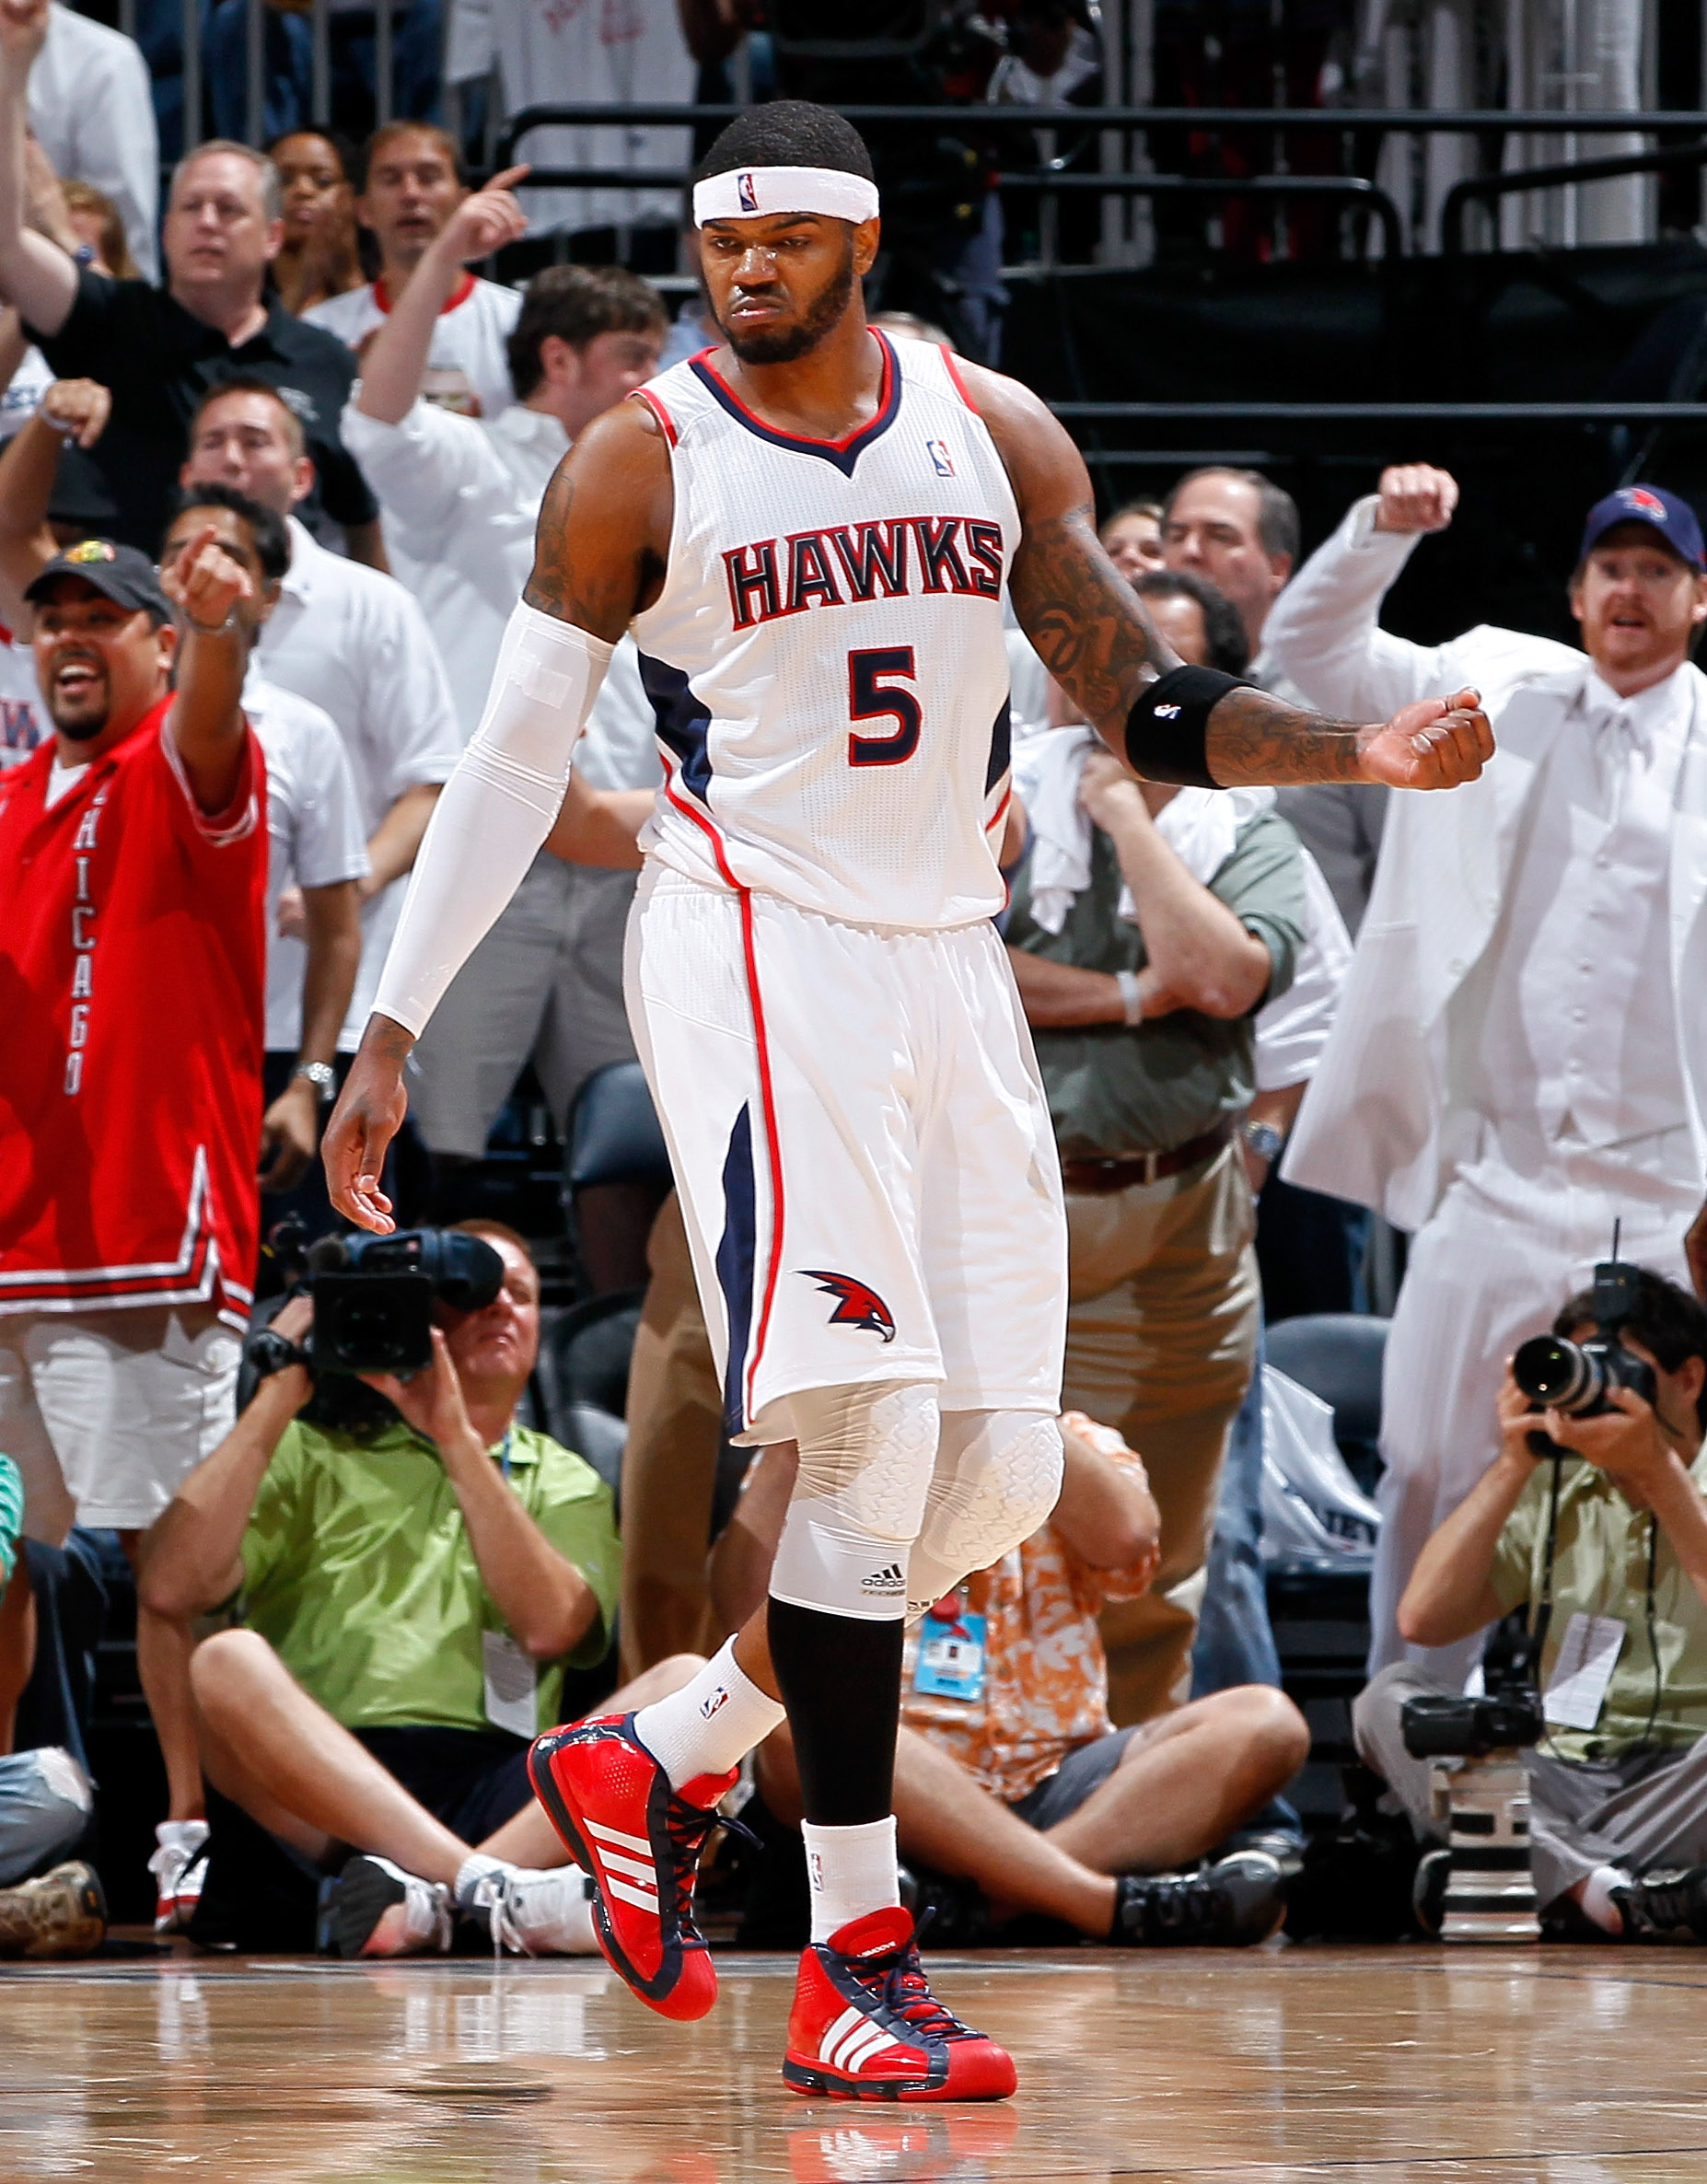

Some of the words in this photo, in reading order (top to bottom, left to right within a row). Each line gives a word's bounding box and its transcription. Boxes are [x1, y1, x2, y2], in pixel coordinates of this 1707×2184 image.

[722, 517, 1003, 631] HAWKS
[848, 645, 923, 767] 5
[862, 1578, 906, 1587] adida
